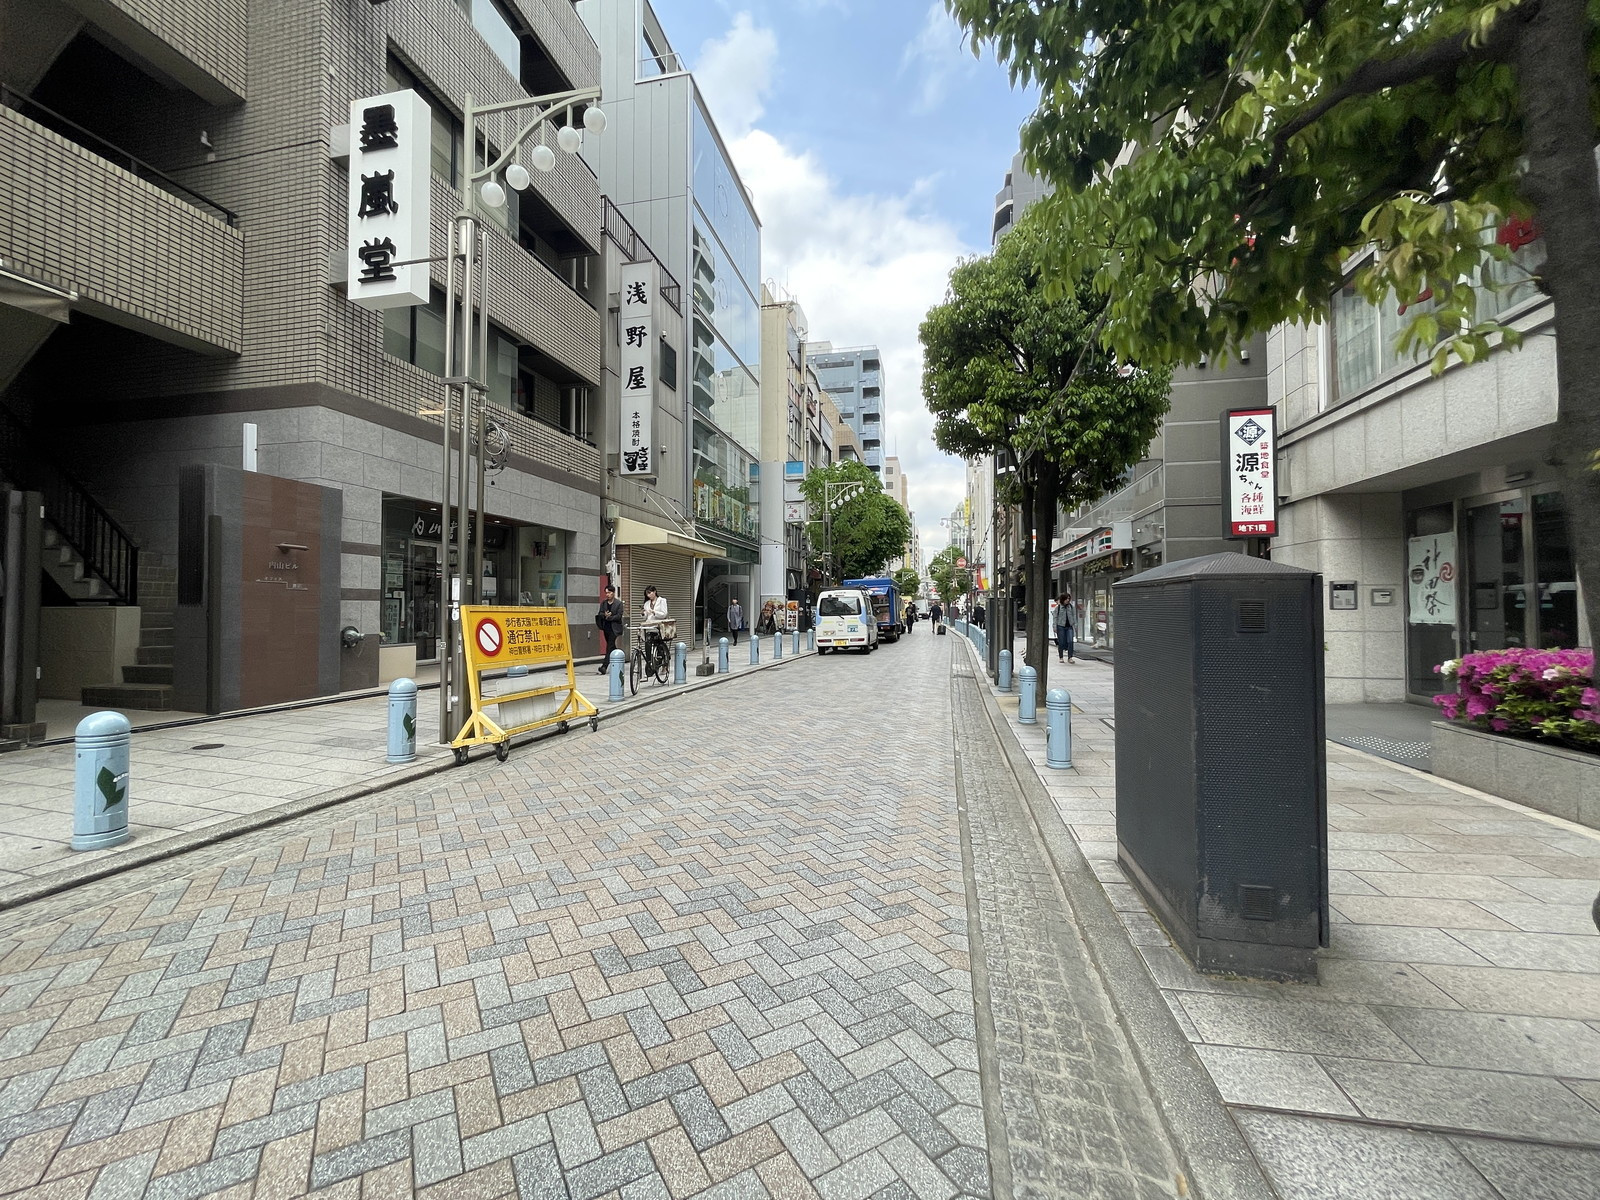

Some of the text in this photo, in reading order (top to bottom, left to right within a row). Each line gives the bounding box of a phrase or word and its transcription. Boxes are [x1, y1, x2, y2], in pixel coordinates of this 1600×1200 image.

[625, 281, 648, 391] 浅野屋
[631, 411, 641, 447] 本格焼酎
[1241, 492, 1263, 503] 各種
[1241, 505, 1264, 515] 海鮮
[1239, 524, 1267, 532] 地下1階
[269, 562, 298, 570] 内山ビル
[505, 617, 532, 627] 歩行者天国
[507, 629, 541, 644] 通行禁止
